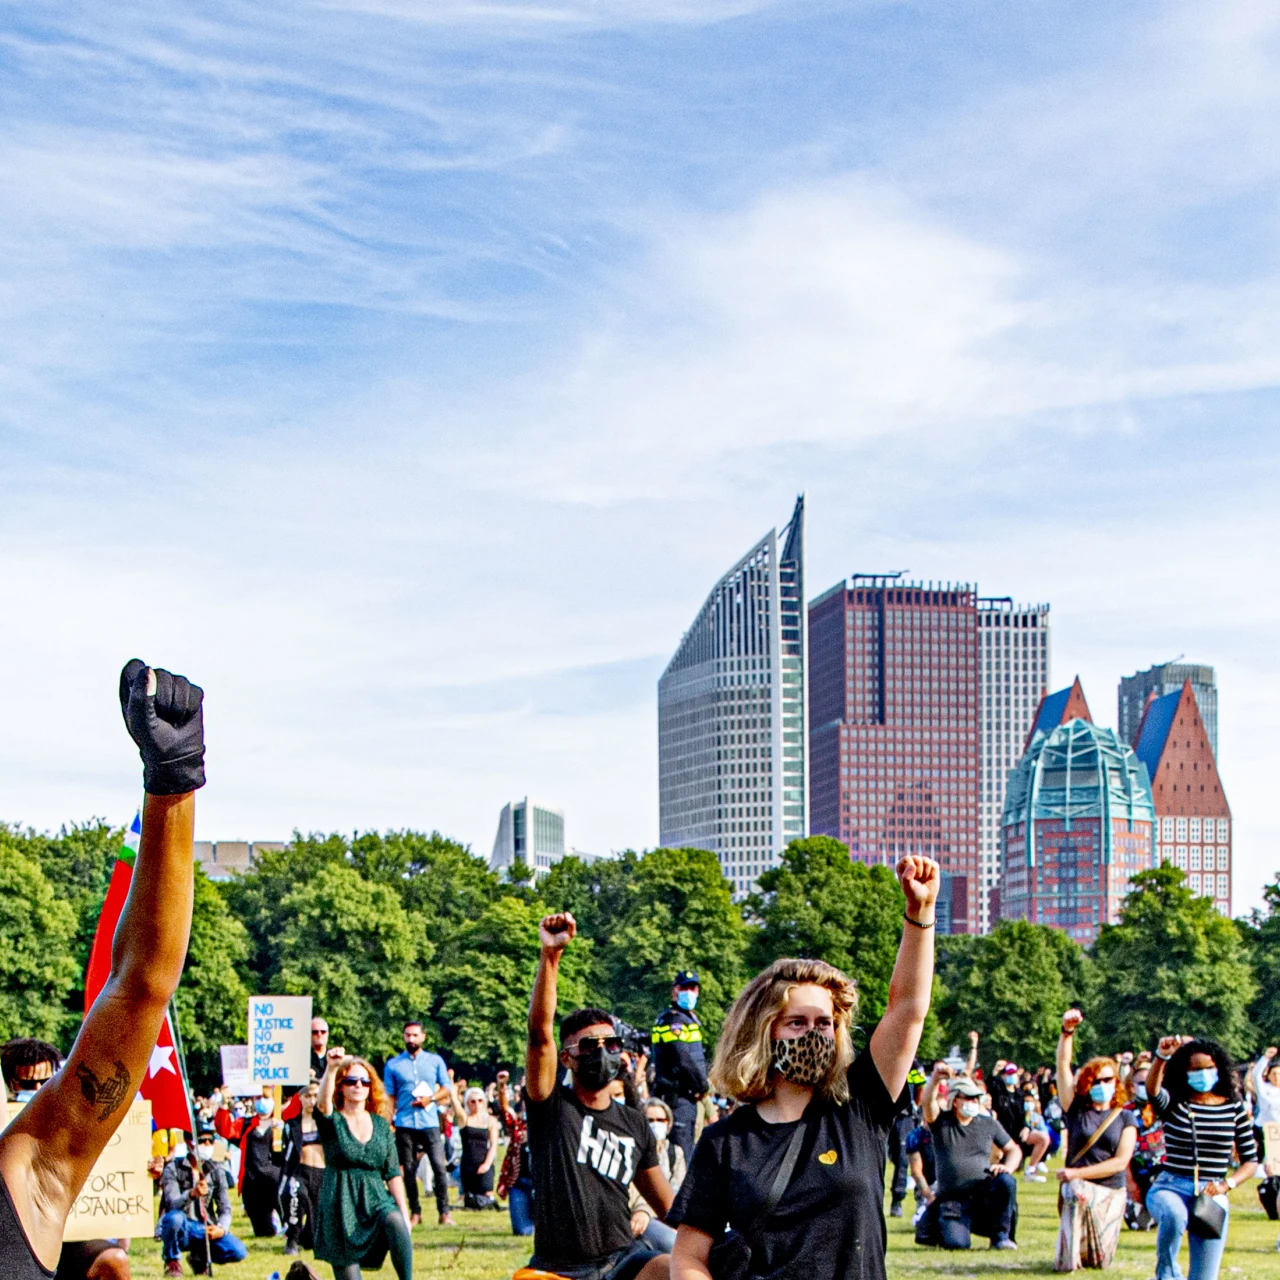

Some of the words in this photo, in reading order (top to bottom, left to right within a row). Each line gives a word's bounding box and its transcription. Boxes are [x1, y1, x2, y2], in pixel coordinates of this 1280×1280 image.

[253, 1003, 274, 1016] NO
[253, 1018, 294, 1030] JUSTICE
[253, 1030, 272, 1042] NO
[253, 1042, 285, 1055] PEACE
[253, 1056, 271, 1066] NO
[253, 1067, 289, 1081] POLICE
